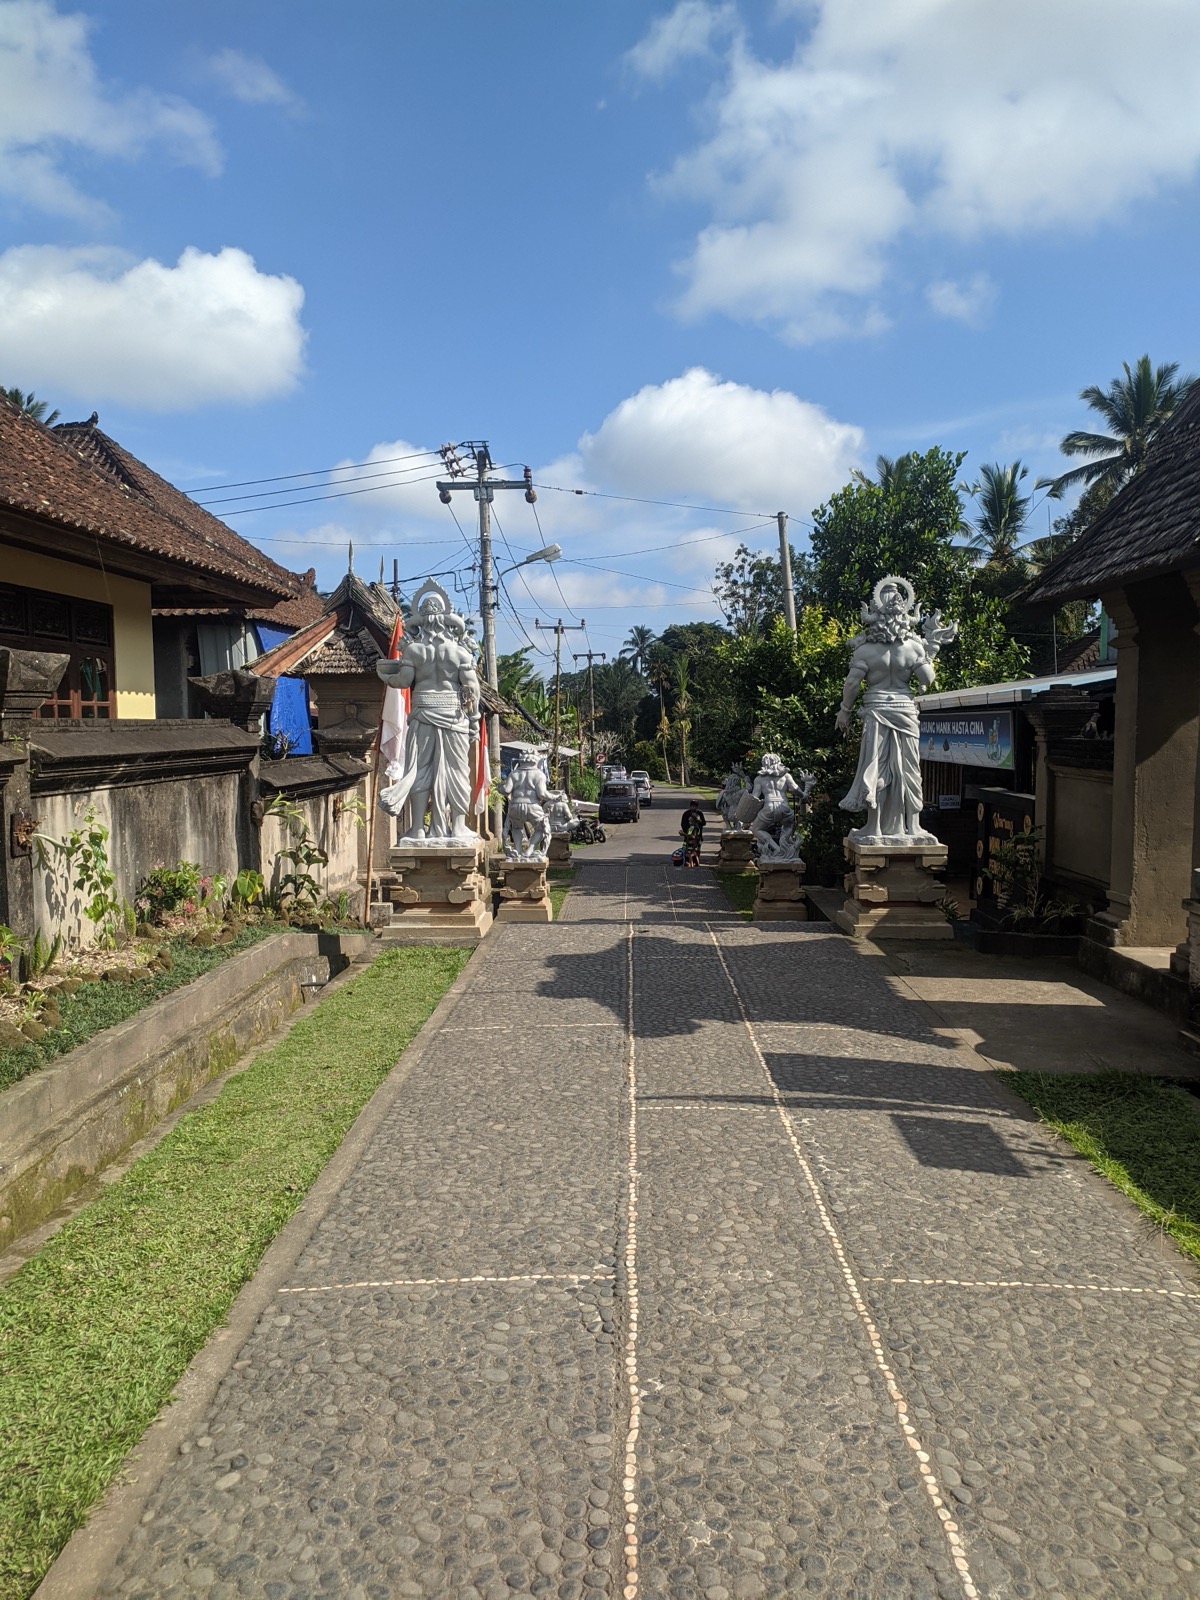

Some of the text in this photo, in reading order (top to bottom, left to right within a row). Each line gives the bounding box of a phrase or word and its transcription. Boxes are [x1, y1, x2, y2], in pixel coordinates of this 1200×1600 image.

[936, 721, 951, 734] MANIK
[952, 721, 969, 735] HASTA
[970, 721, 984, 735] GINA
[993, 812, 1013, 838] Warung
